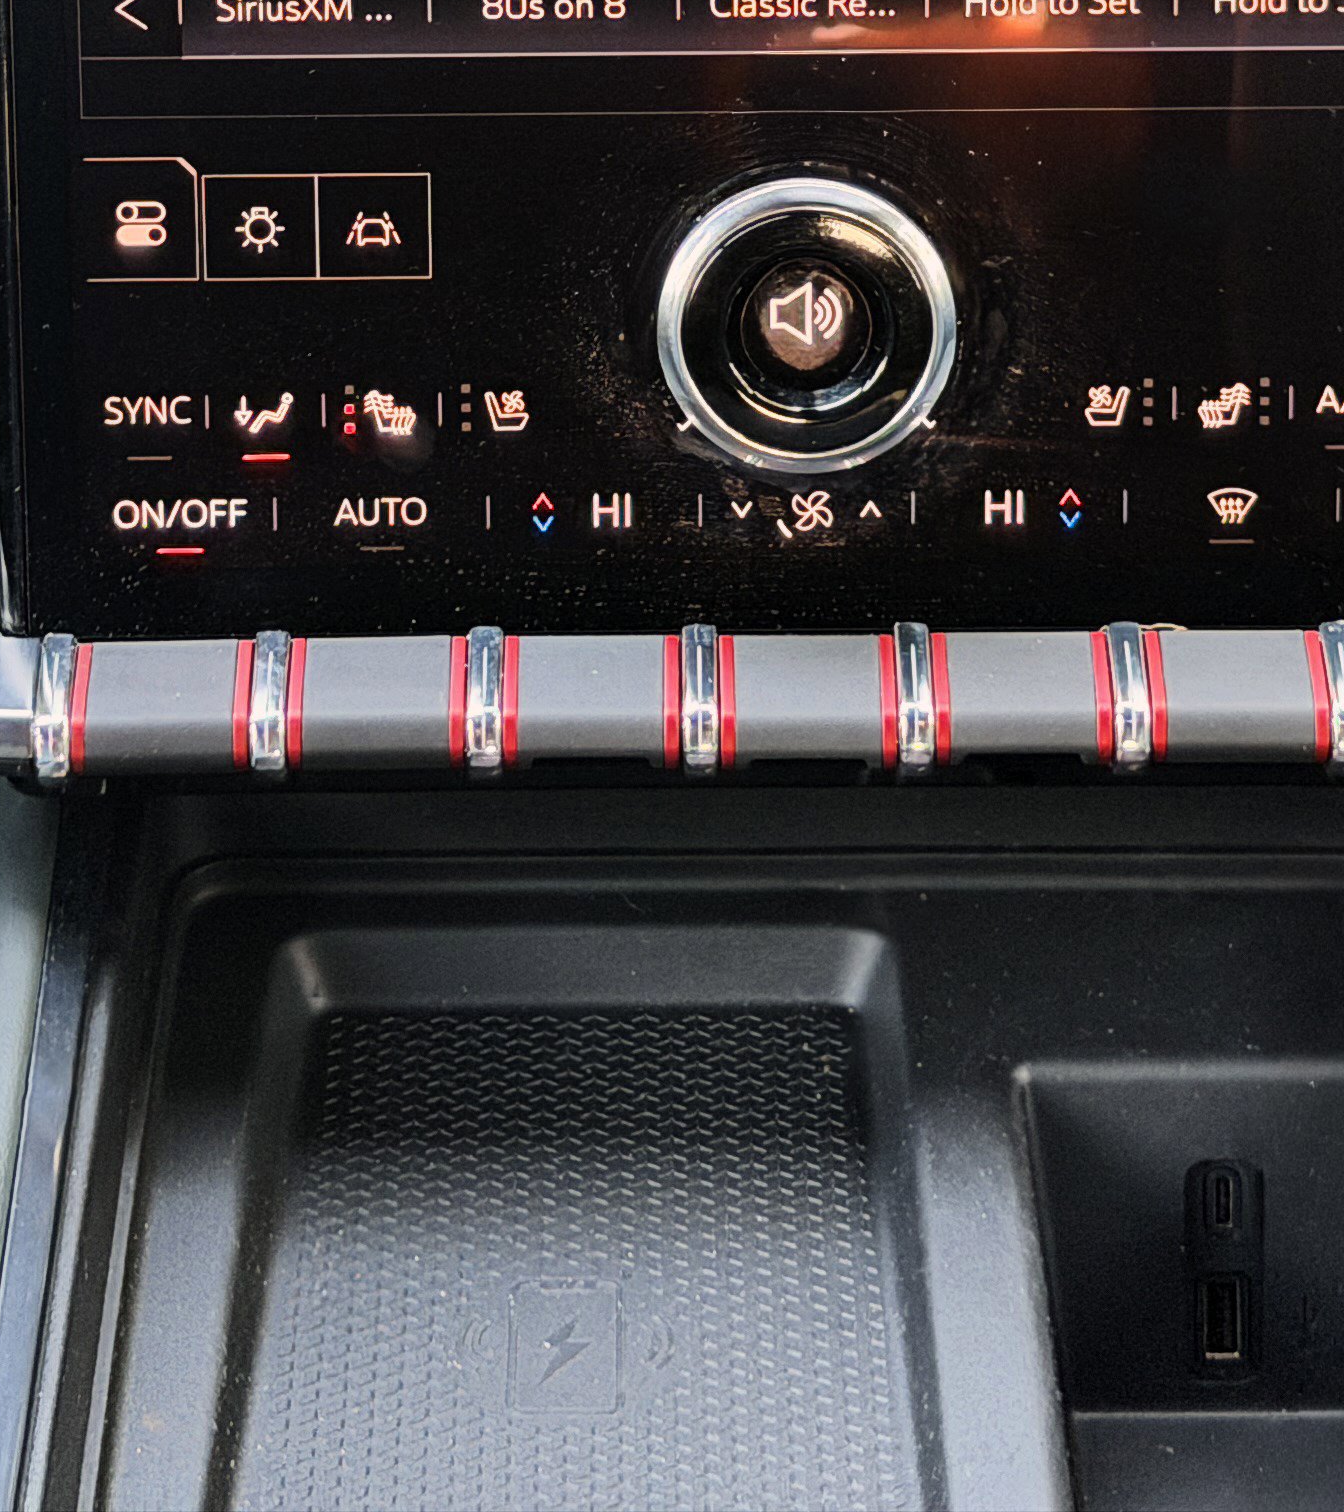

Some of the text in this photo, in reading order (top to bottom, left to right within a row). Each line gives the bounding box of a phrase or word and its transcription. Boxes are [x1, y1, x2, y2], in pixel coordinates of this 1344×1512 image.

[103, 395, 193, 426] SYNC
[112, 498, 249, 530] ON/OFF
[333, 496, 428, 527] AUTO
[591, 492, 632, 529] HI
[983, 489, 1025, 525] HI
